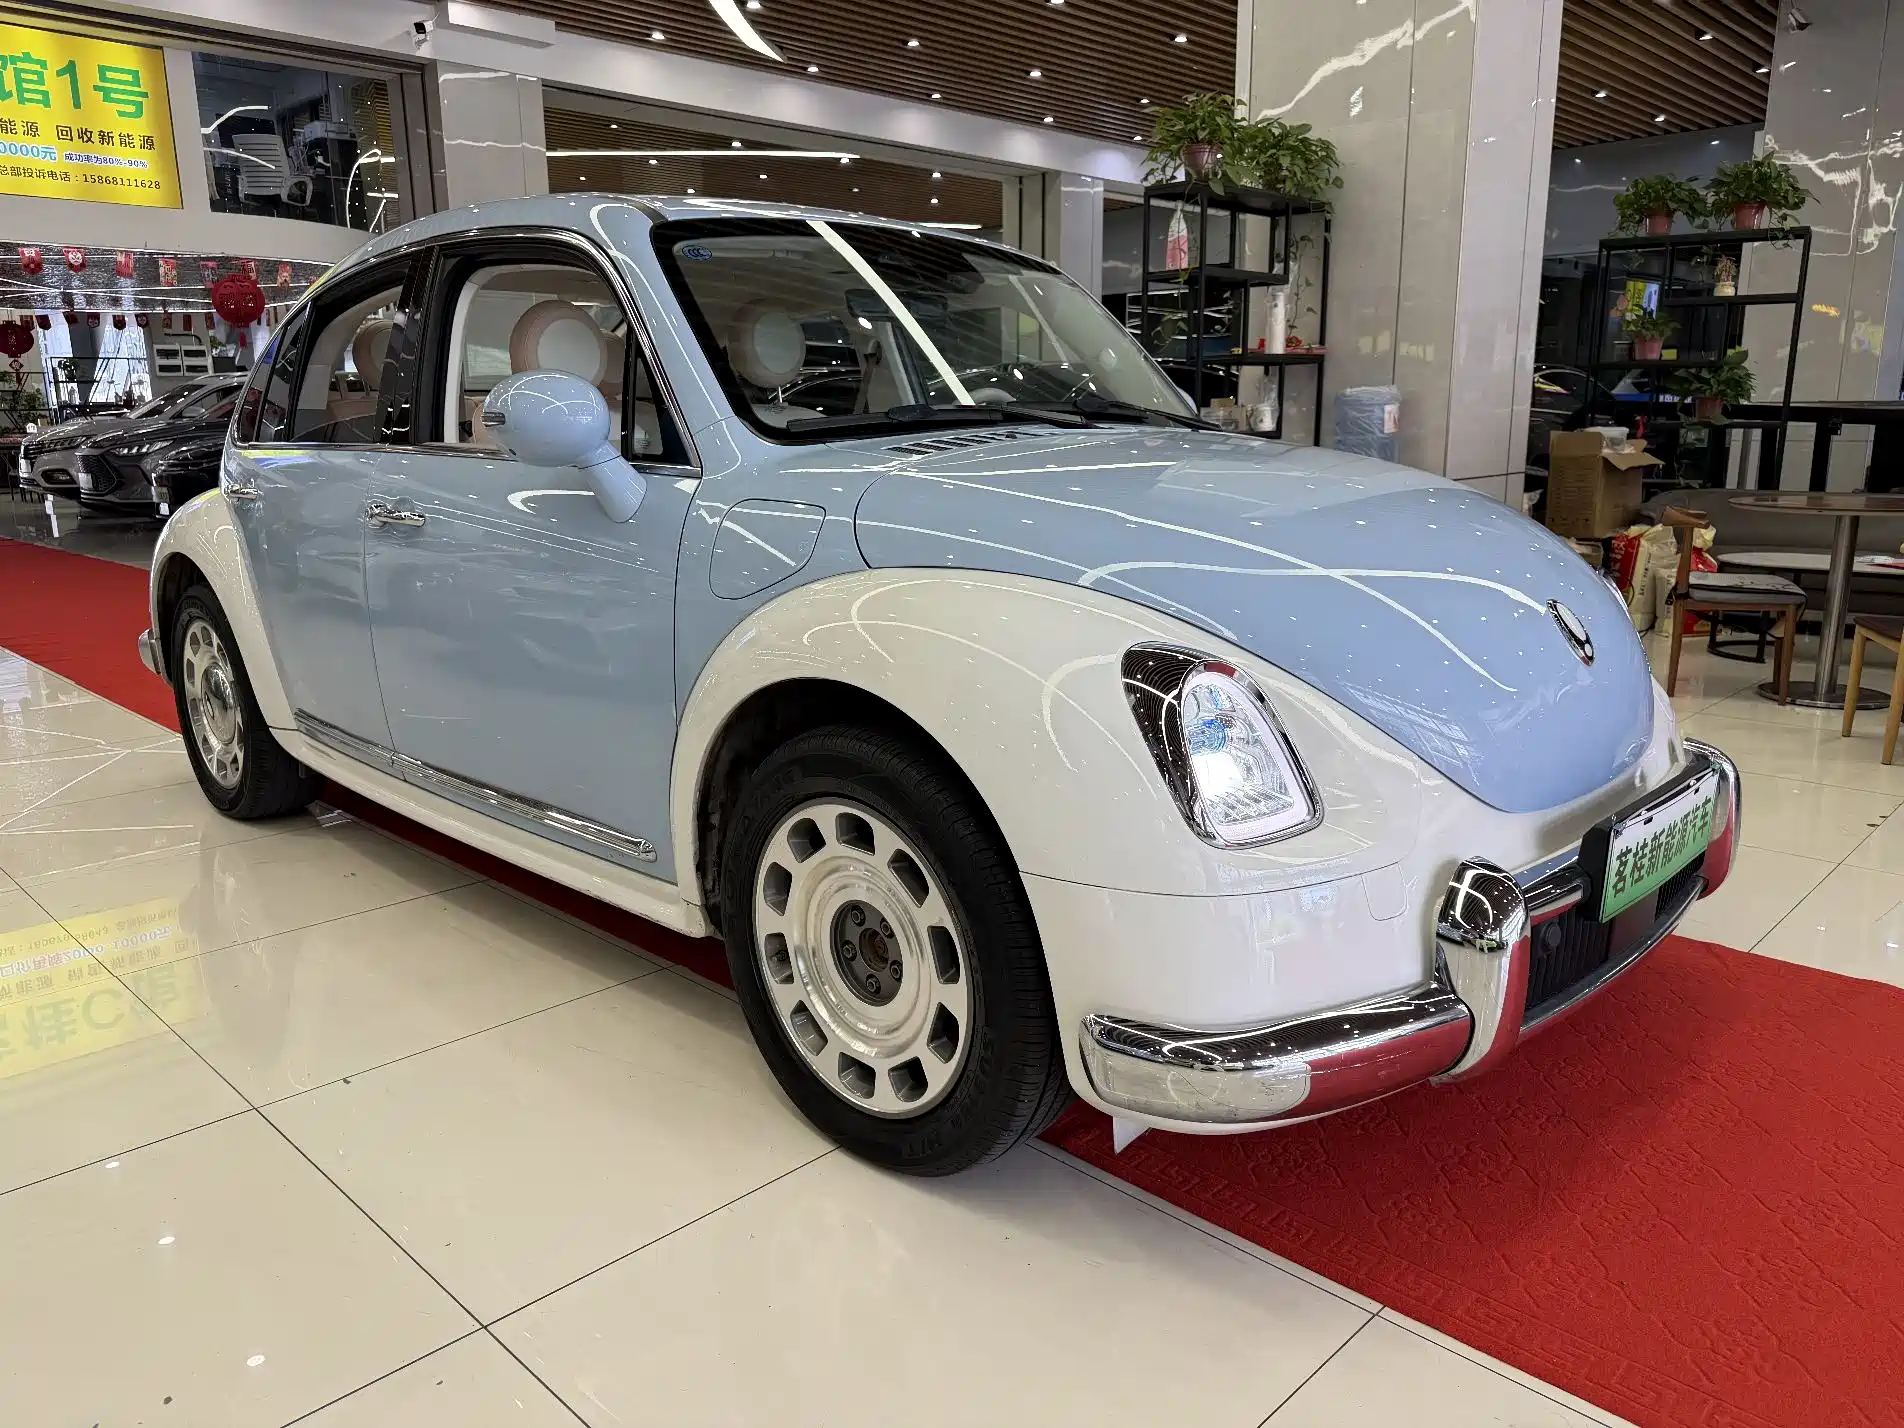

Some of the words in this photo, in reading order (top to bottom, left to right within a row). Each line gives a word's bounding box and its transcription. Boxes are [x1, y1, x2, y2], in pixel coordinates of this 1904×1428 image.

[0, 52, 149, 119] 馆1号
[0, 117, 40, 138] 能源
[56, 124, 156, 151] 回收新能源
[64, 152, 148, 169] 成功率为80%-90%
[1612, 796, 1713, 898] 茗桂新能源汽车
